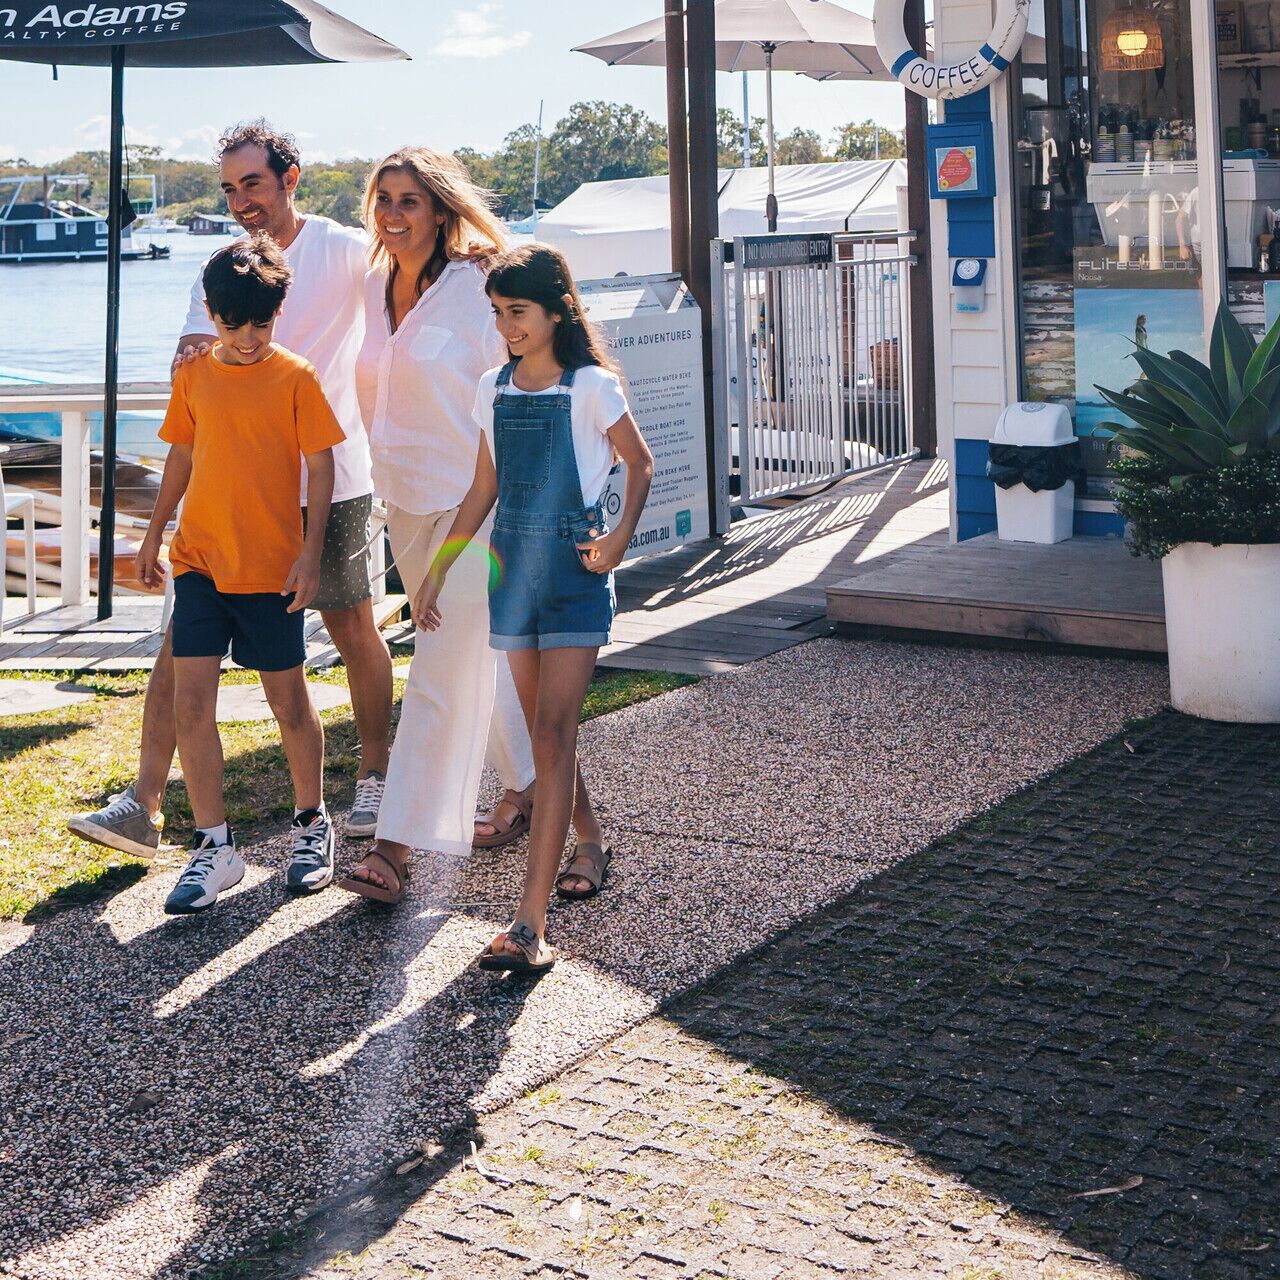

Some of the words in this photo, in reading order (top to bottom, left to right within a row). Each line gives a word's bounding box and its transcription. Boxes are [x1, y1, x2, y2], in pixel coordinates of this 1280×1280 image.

[24, 1, 188, 28] Adams
[84, 22, 182, 39] COFFEE
[909, 56, 985, 89] COFFEE
[748, 243, 759, 260] NO
[810, 239, 829, 256] ENTRY
[1078, 273, 1102, 281] Noosa
[608, 336, 635, 349] RIVER
[638, 329, 692, 345] ADVENTURES
[665, 466, 677, 476] BIKE
[629, 526, 670, 549] sa.com.au
